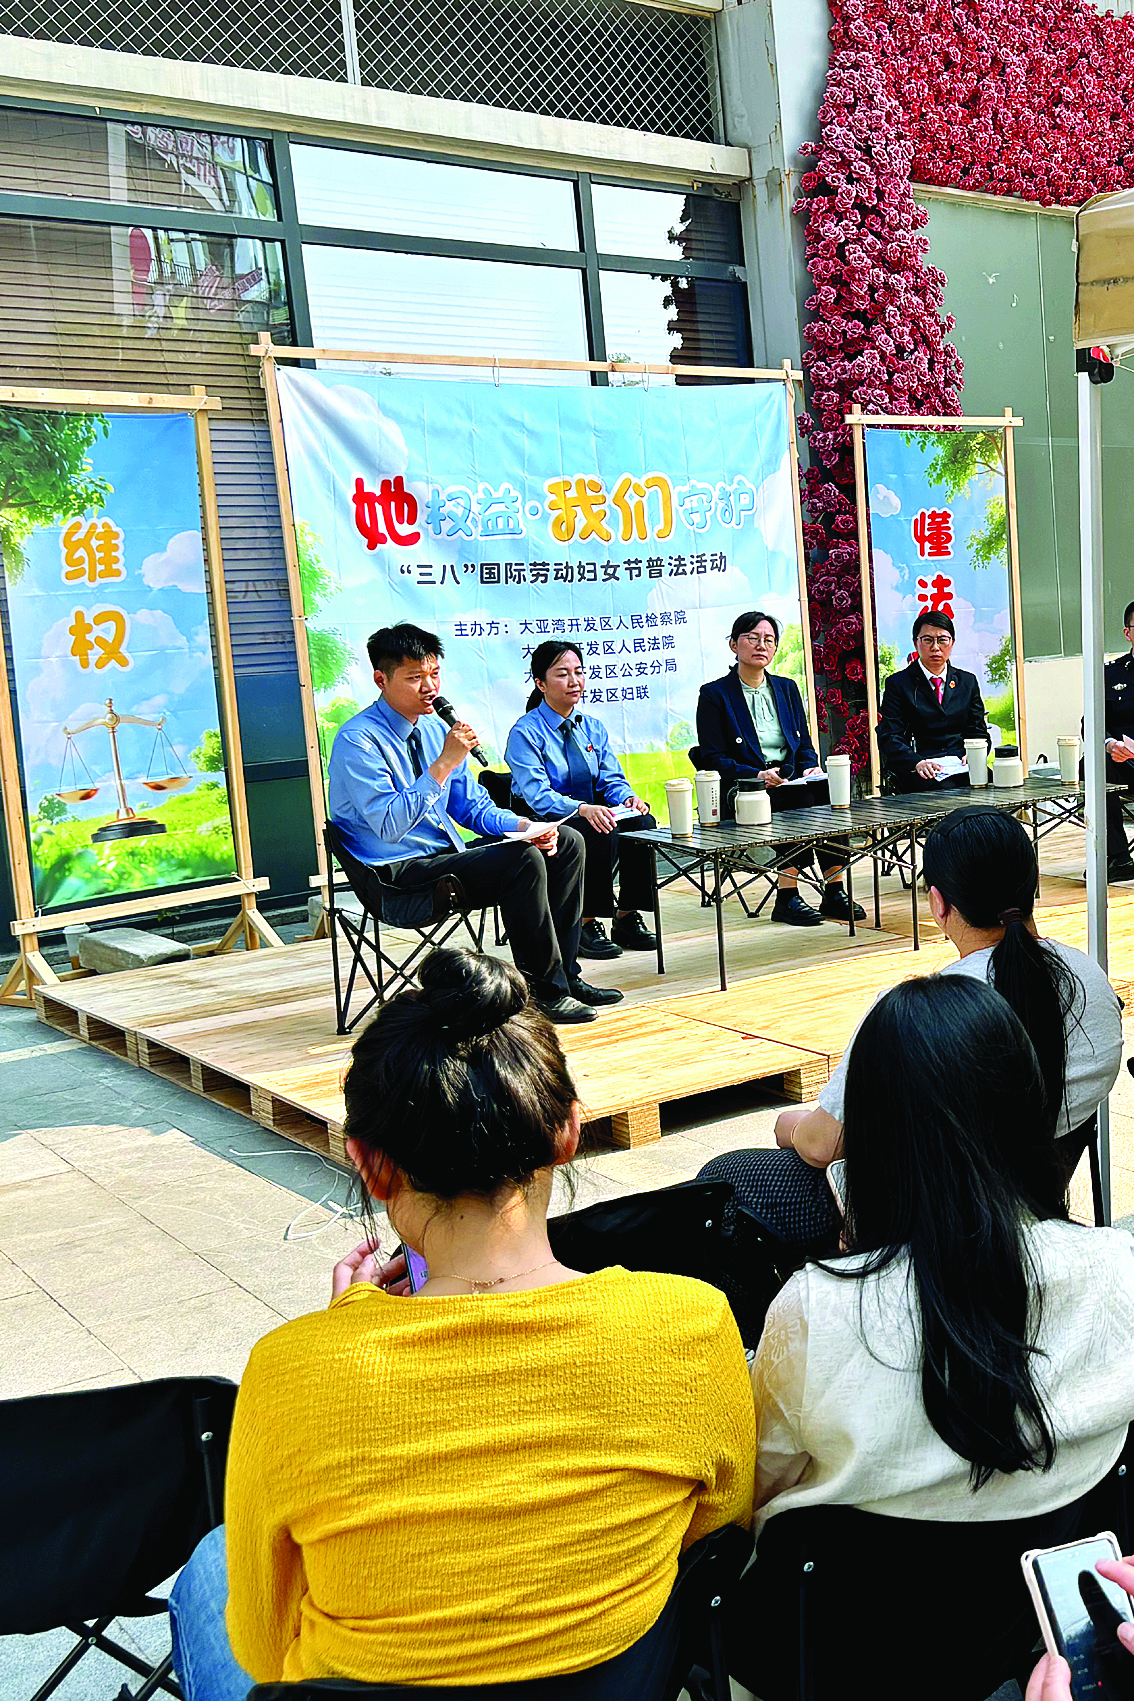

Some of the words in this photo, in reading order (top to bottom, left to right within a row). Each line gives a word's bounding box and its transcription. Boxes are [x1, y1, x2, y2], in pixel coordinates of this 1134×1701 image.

[63, 519, 130, 669] 维权
[913, 510, 955, 620] 懂法
[522, 635, 676, 660] 大发区人民法院
